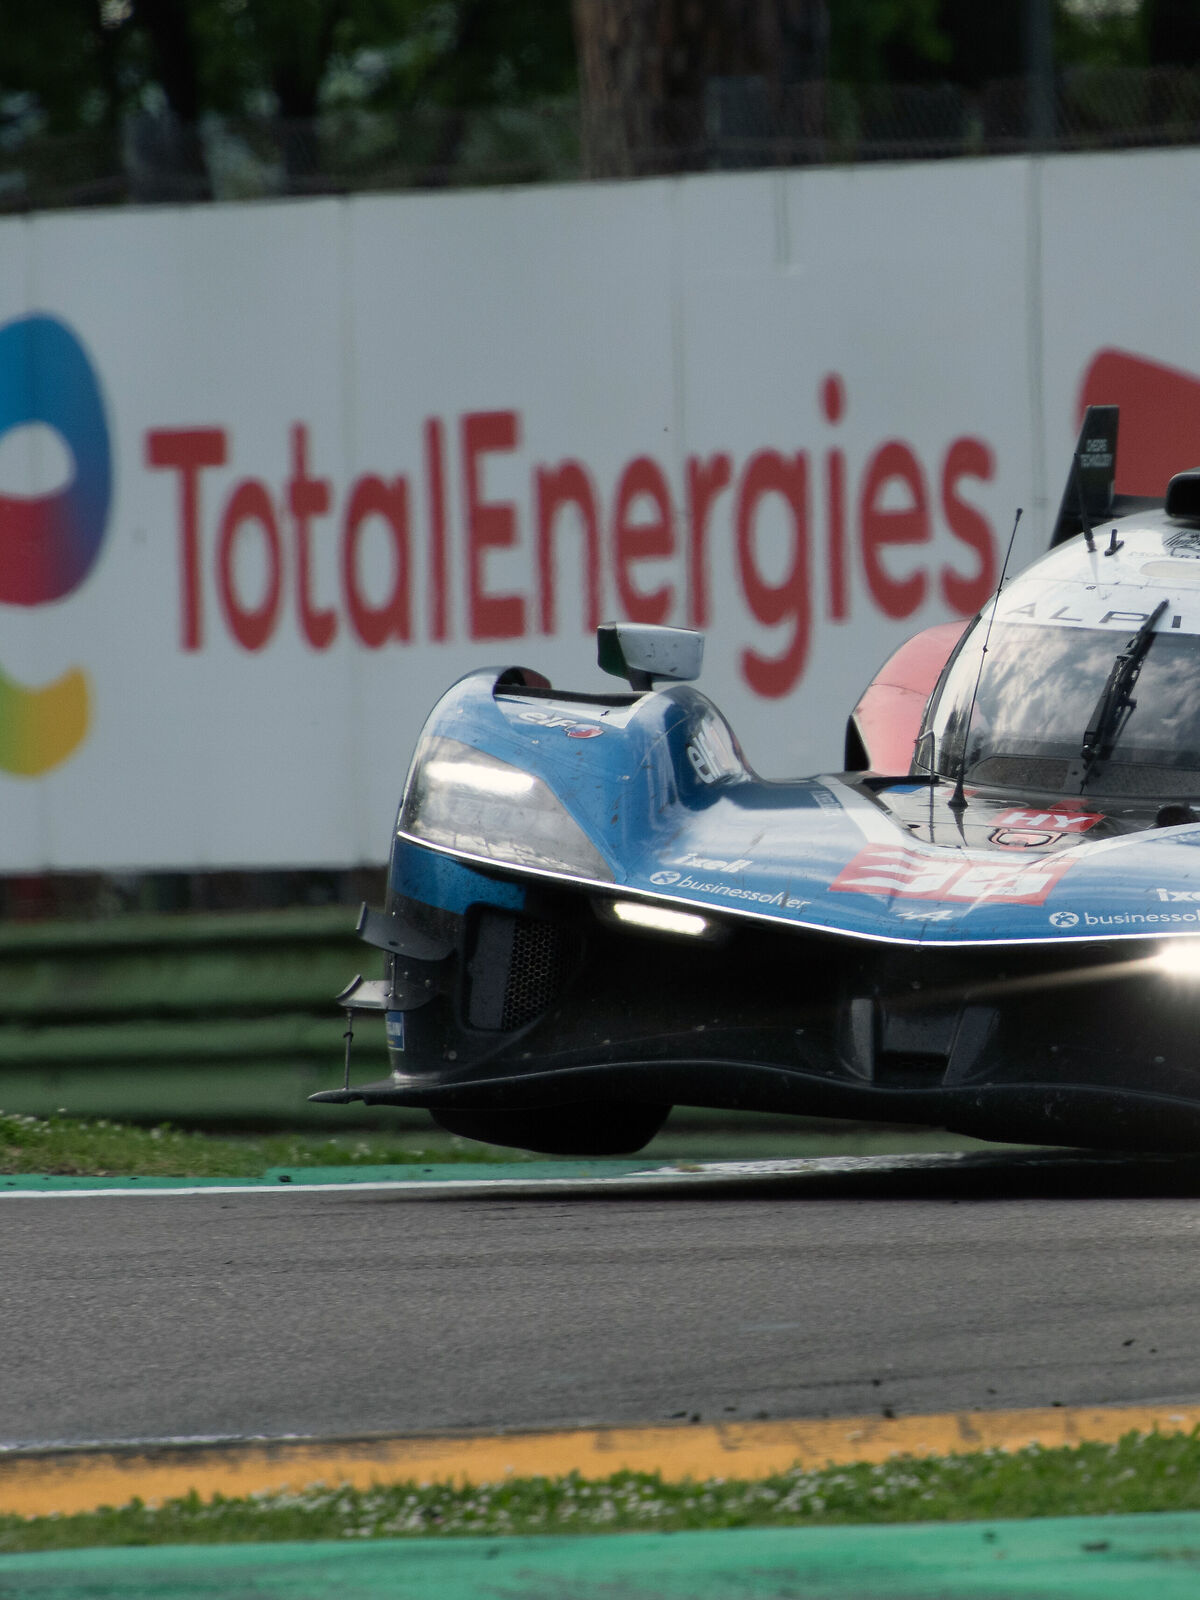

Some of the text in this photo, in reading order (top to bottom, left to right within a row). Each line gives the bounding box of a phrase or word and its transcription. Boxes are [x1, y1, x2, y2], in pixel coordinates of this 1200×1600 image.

[145, 372, 996, 698] TotalEnergies
[518, 711, 576, 729] elf
[1001, 811, 1097, 830] HY
[673, 853, 753, 874] ixell
[678, 874, 812, 910] businessolver
